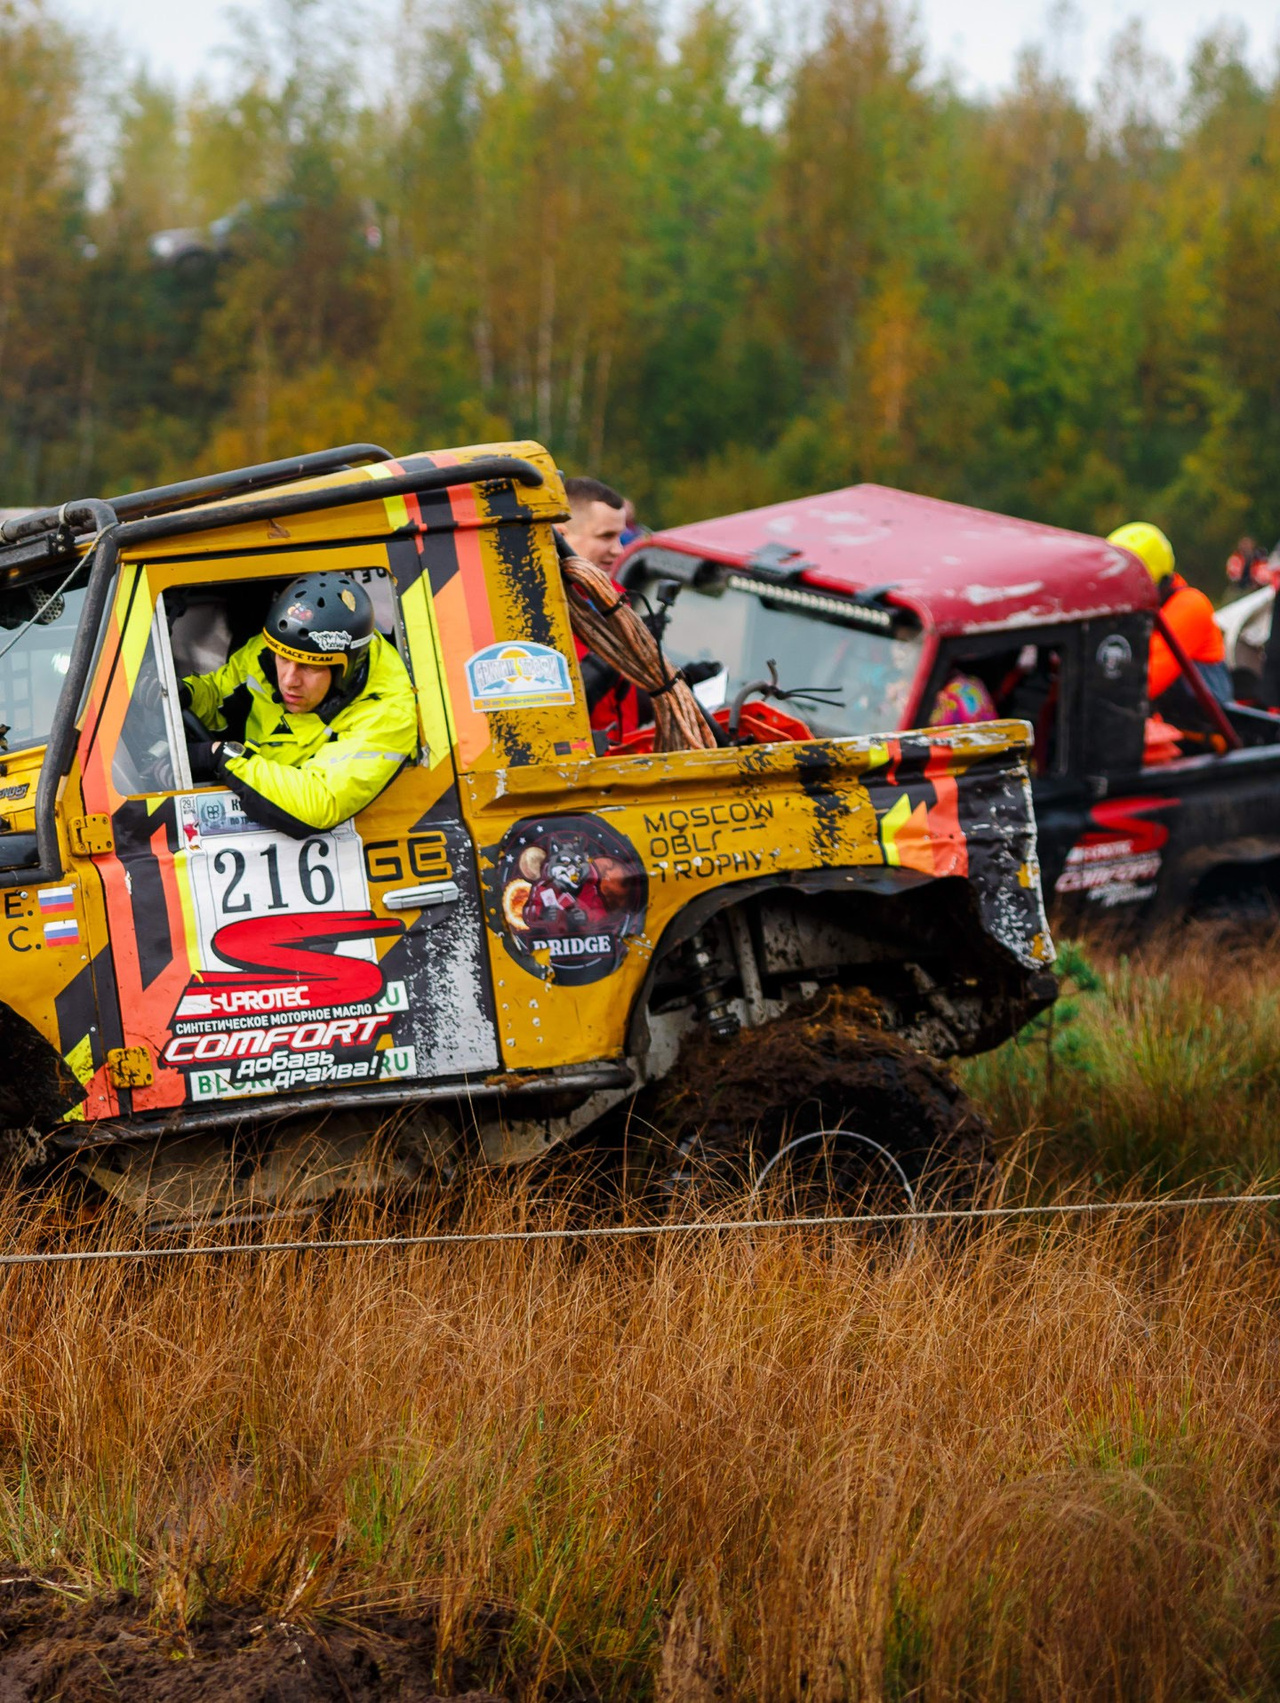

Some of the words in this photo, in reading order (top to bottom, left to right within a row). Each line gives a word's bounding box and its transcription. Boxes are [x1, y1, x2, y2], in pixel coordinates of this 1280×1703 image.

[281, 647, 305, 659] RACE
[643, 799, 774, 834] MOSCOW
[214, 839, 335, 914] 216
[651, 850, 761, 883] TROPHY
[4, 891, 34, 919] Е.
[8, 926, 41, 953] С.
[211, 985, 311, 1013] SUPROTEC
[176, 1015, 269, 1034] СИНТЕТИЧЕСКОЕ
[271, 1007, 331, 1028] МОТОРНОЕ
[332, 1003, 372, 1018] МАСЛО
[164, 1014, 390, 1062] COMFORT
